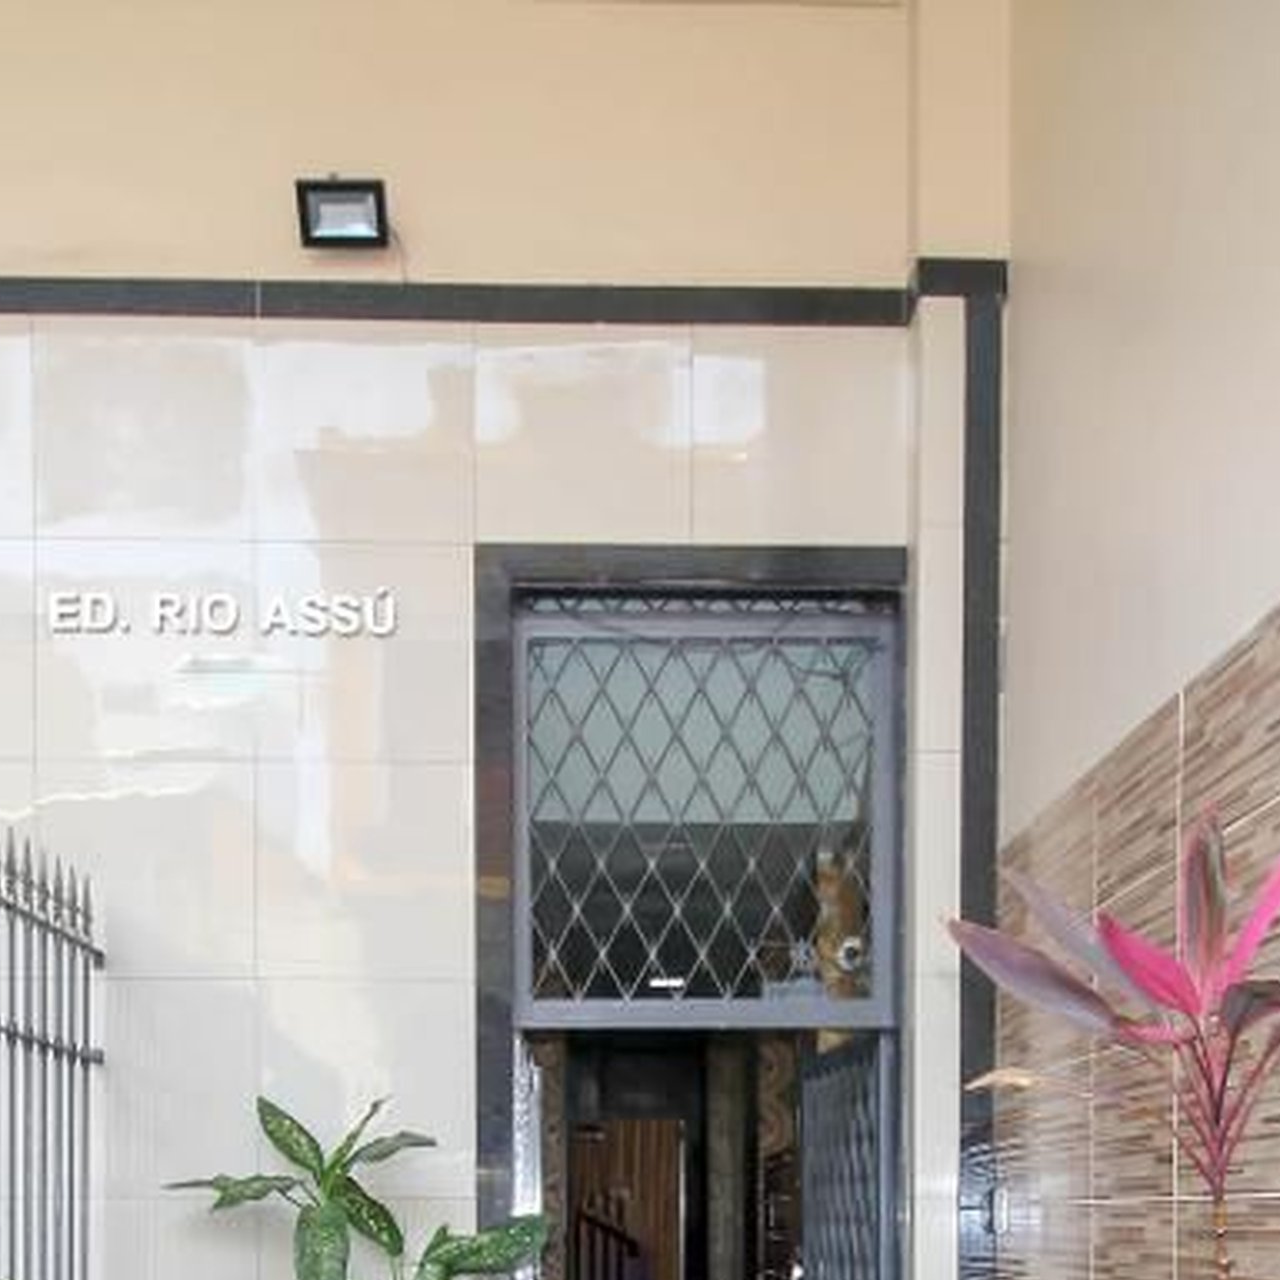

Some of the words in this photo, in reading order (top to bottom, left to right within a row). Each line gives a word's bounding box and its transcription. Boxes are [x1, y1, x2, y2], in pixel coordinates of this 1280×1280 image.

[51, 592, 131, 635] ED.
[153, 593, 240, 637] RIO
[262, 585, 401, 639] ASSÚ
